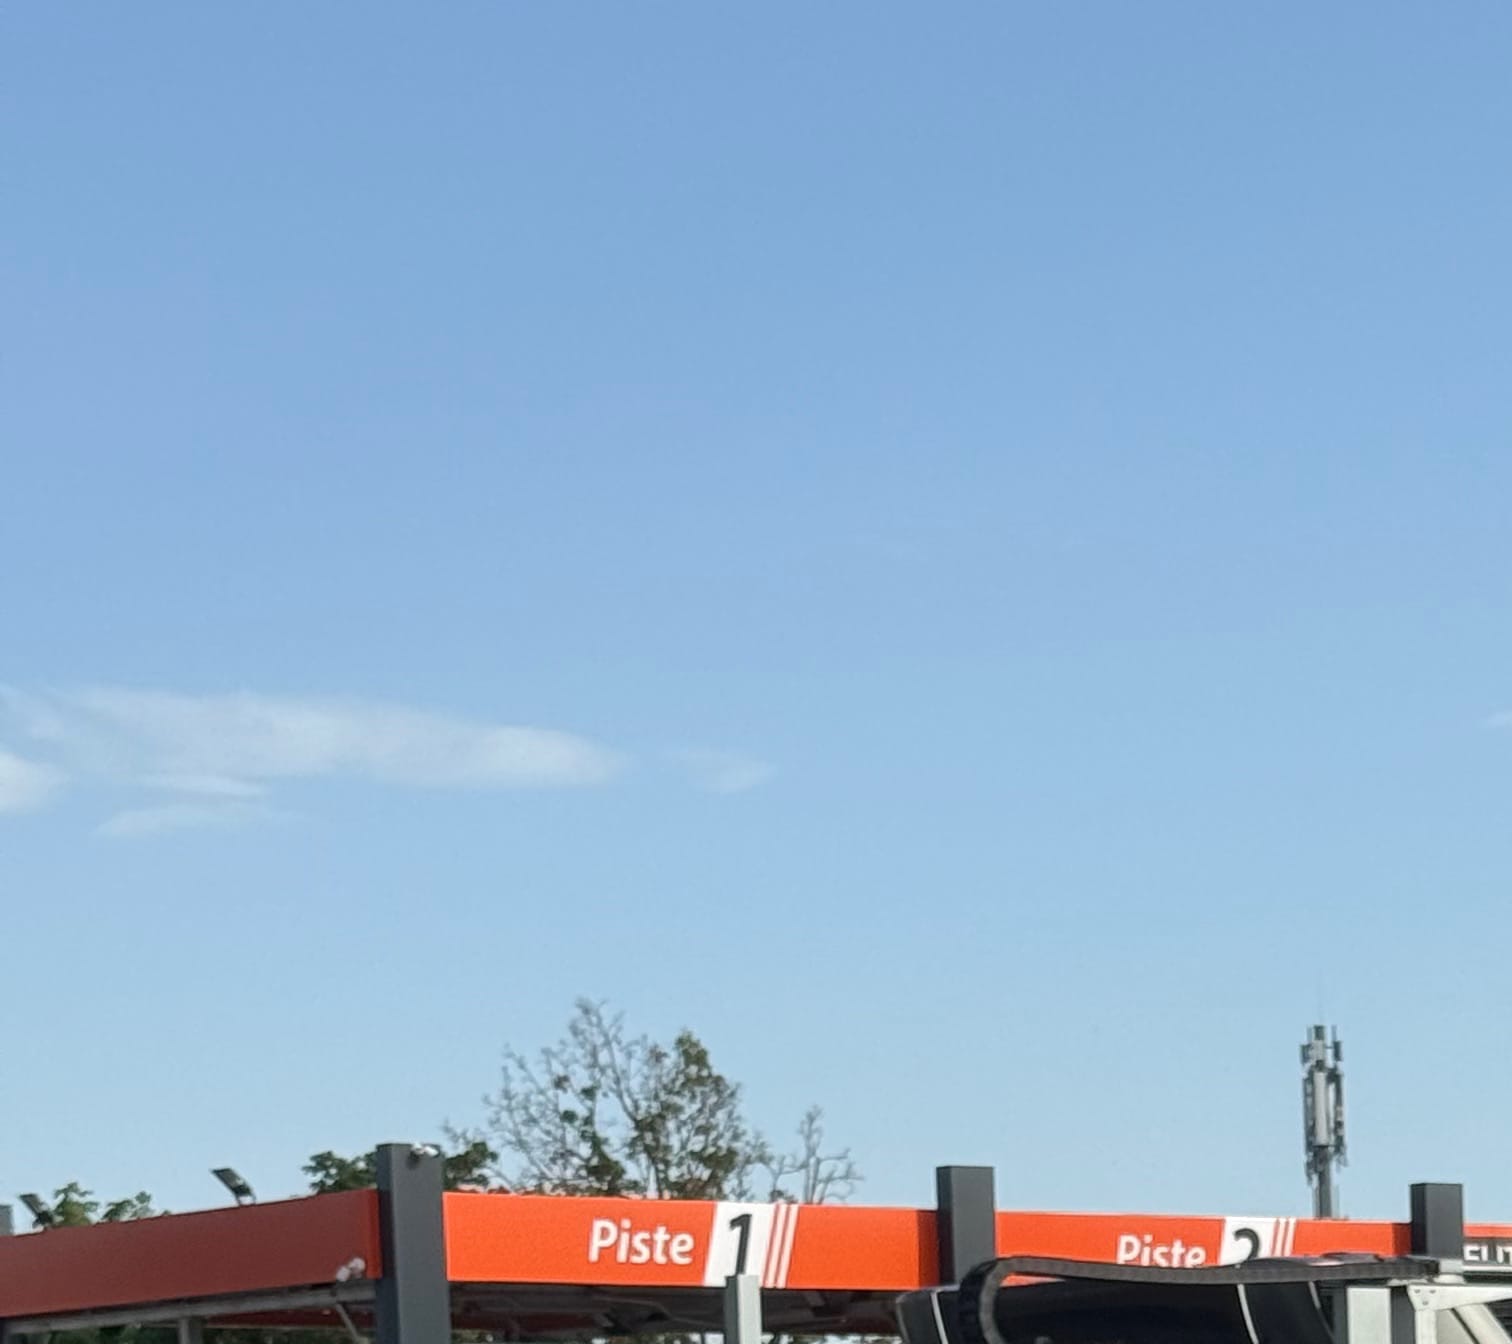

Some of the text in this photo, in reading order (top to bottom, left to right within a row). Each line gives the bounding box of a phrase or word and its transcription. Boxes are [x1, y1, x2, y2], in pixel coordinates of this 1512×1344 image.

[588, 1213, 752, 1275] Piste 1
[1116, 1233, 1207, 1268] Piste
